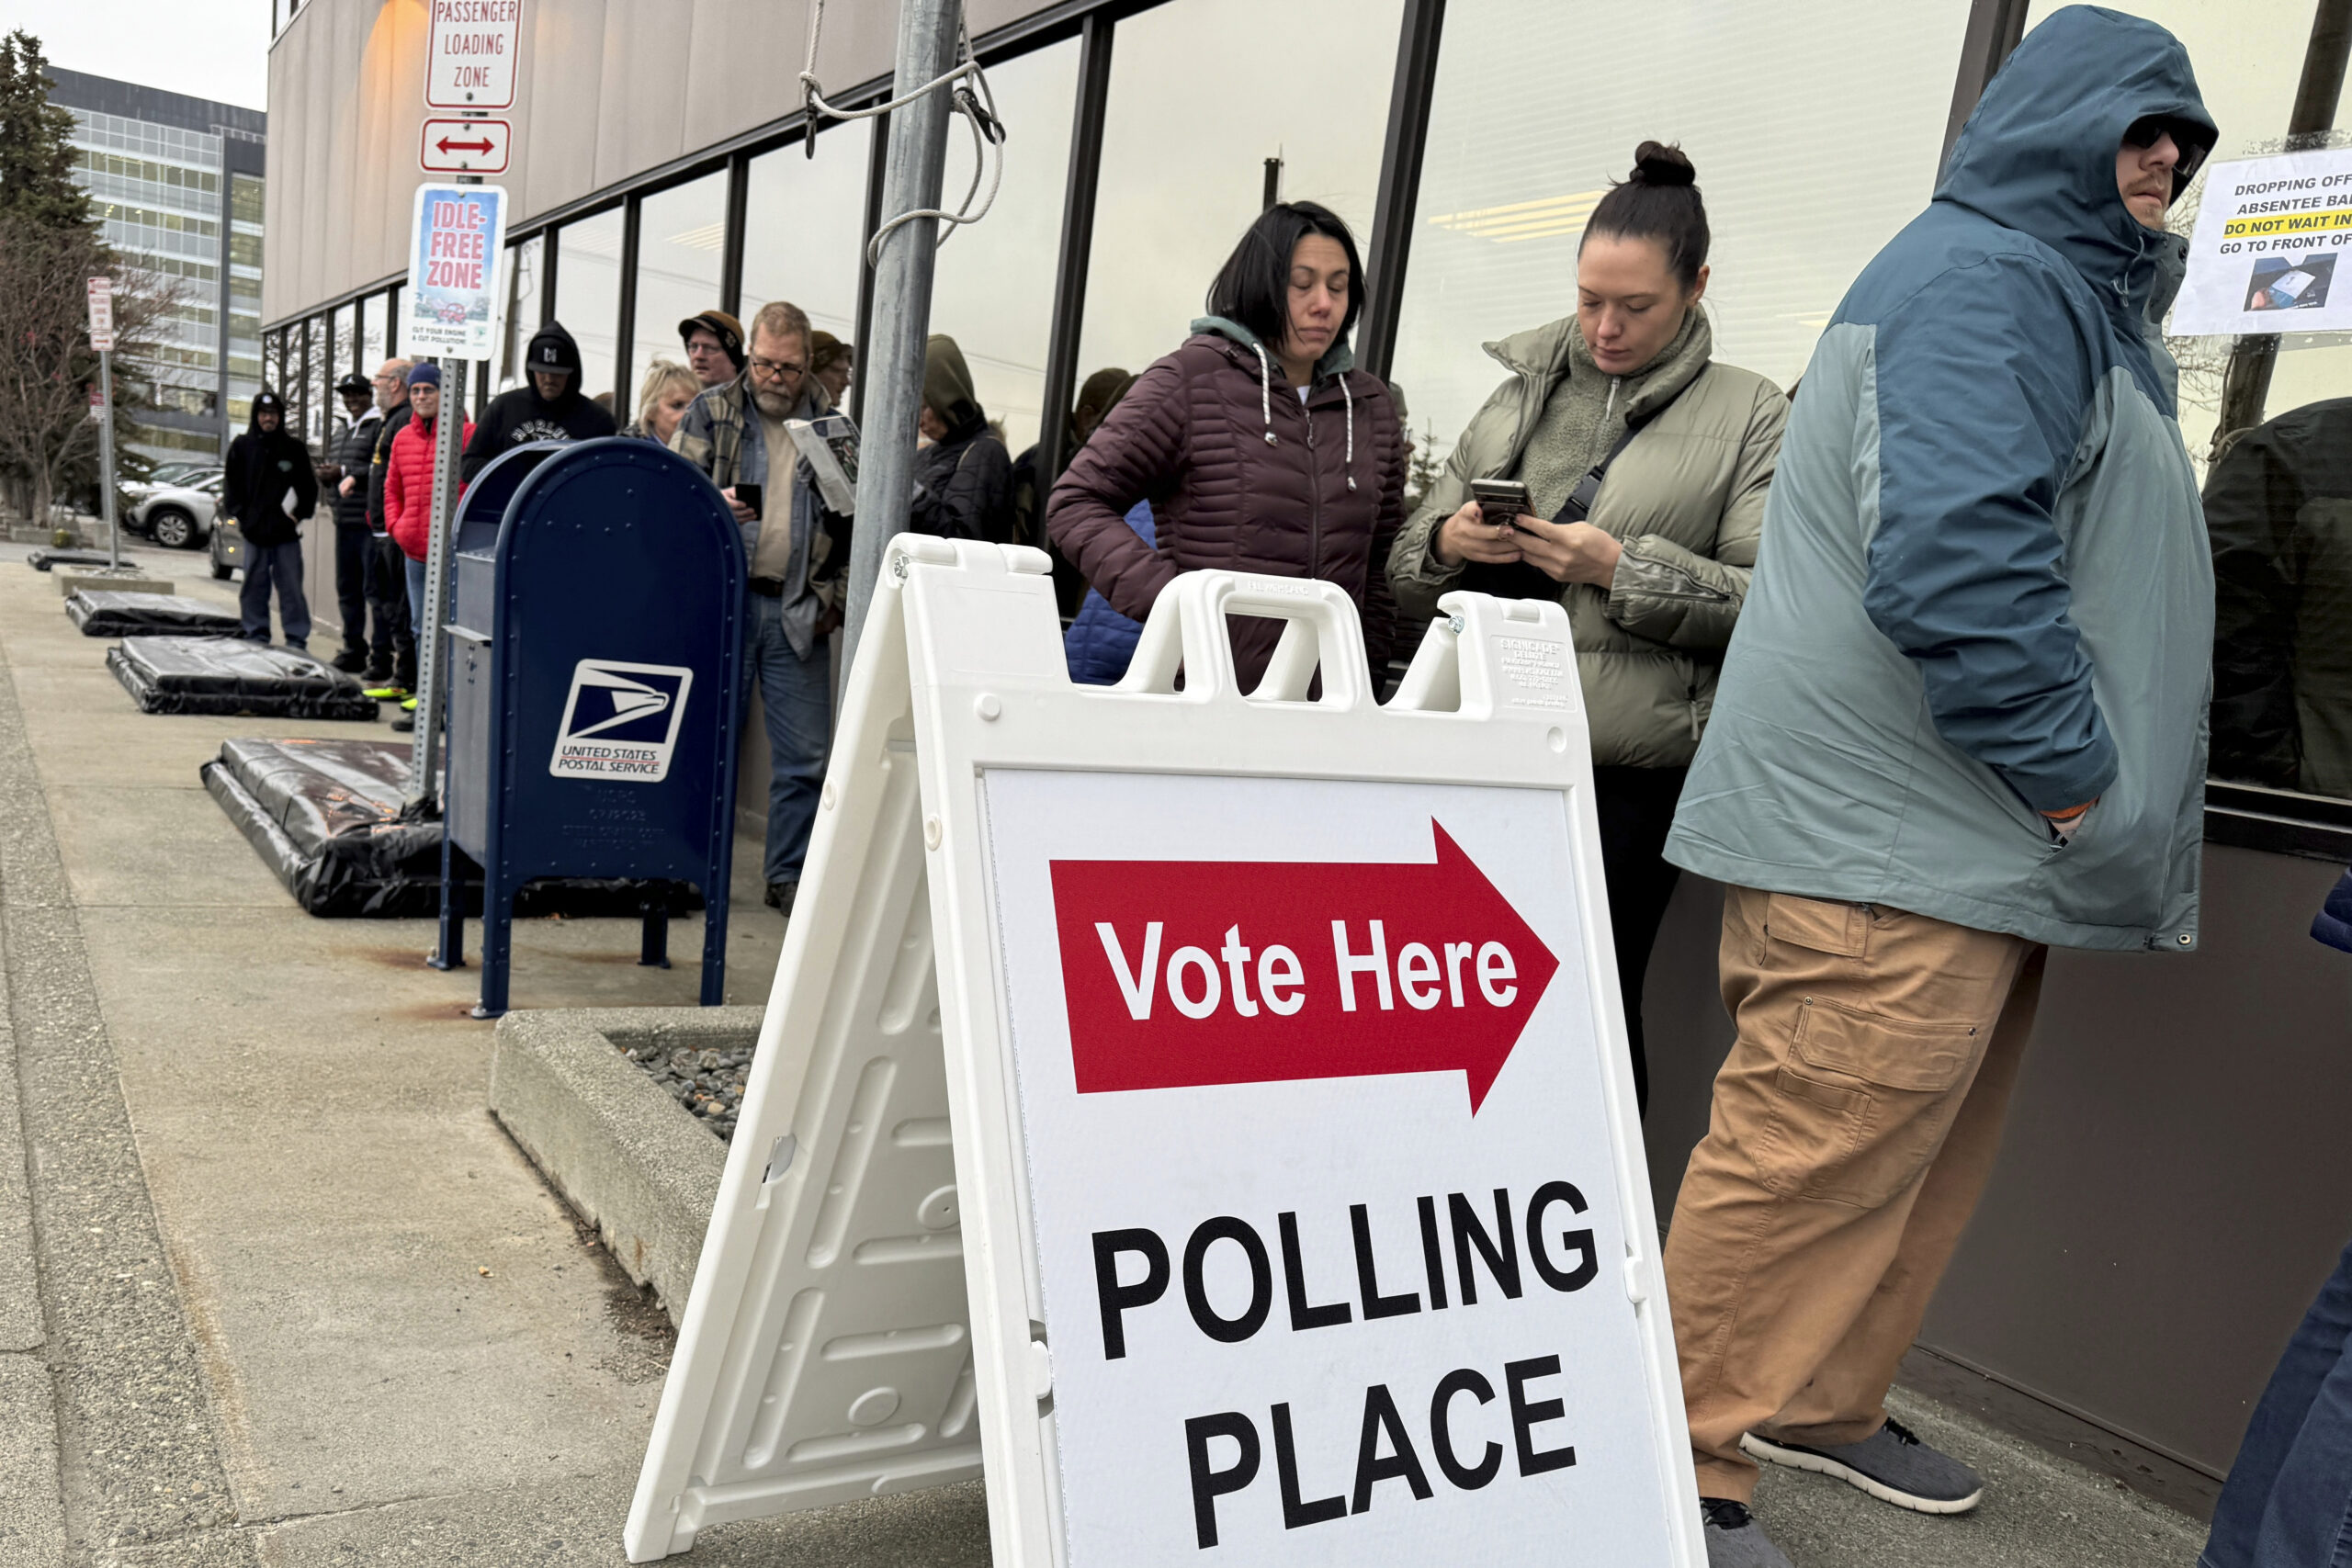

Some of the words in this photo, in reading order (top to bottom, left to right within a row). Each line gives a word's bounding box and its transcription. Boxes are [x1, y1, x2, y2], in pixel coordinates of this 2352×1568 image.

[436, 1, 516, 22] PASSENGER
[444, 33, 503, 55] LOADING
[454, 66, 490, 87] ZONE
[2234, 178, 2316, 196] DROPPING
[433, 201, 487, 230] IDLE-
[2237, 197, 2322, 215] ABSENTEE
[2224, 223, 2246, 235] DO
[2250, 220, 2284, 232] NOT
[2289, 216, 2330, 229] WAIT
[2334, 213, 2352, 226] IN
[430, 231, 484, 260] FREE
[2220, 243, 2242, 254] GO
[2247, 241, 2267, 253] TO
[2272, 235, 2326, 251] FRONT
[425, 260, 482, 290] ZONE
[561, 745, 612, 758] UNITED
[613, 748, 657, 761] STATES
[559, 759, 606, 772] POSTAL
[608, 761, 660, 774] SERVICE
[1094, 921, 1306, 1021] Vote
[1331, 919, 1519, 1012] Here
[1091, 1180, 1599, 1360] POLLING
[1185, 1354, 1577, 1550] PLACE
